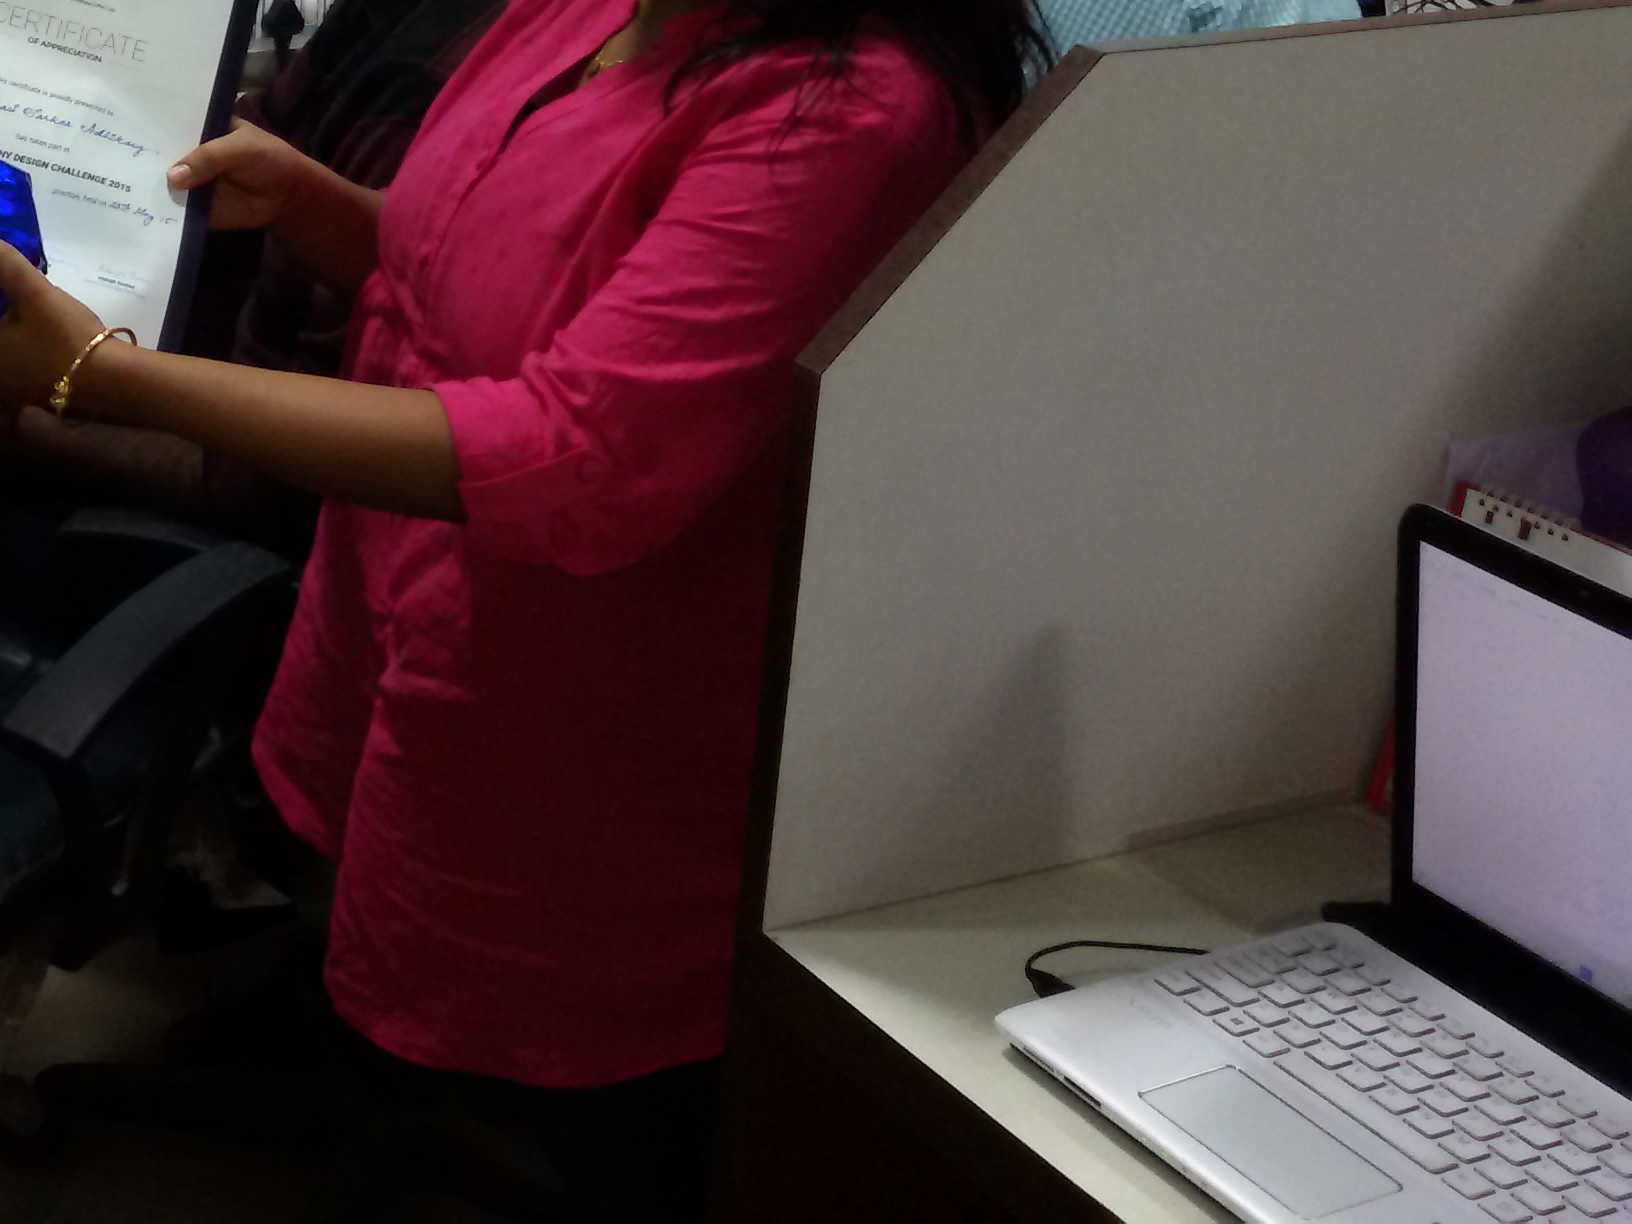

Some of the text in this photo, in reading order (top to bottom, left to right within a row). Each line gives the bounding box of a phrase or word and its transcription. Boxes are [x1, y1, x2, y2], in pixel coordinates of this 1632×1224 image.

[27, 35, 103, 63] OF APPRECIATION
[28, 137, 47, 147] taken
[47, 142, 62, 152] part
[13, 153, 49, 170] DESIGN
[50, 163, 108, 185] CHALLENGE
[108, 178, 132, 193] 2015
